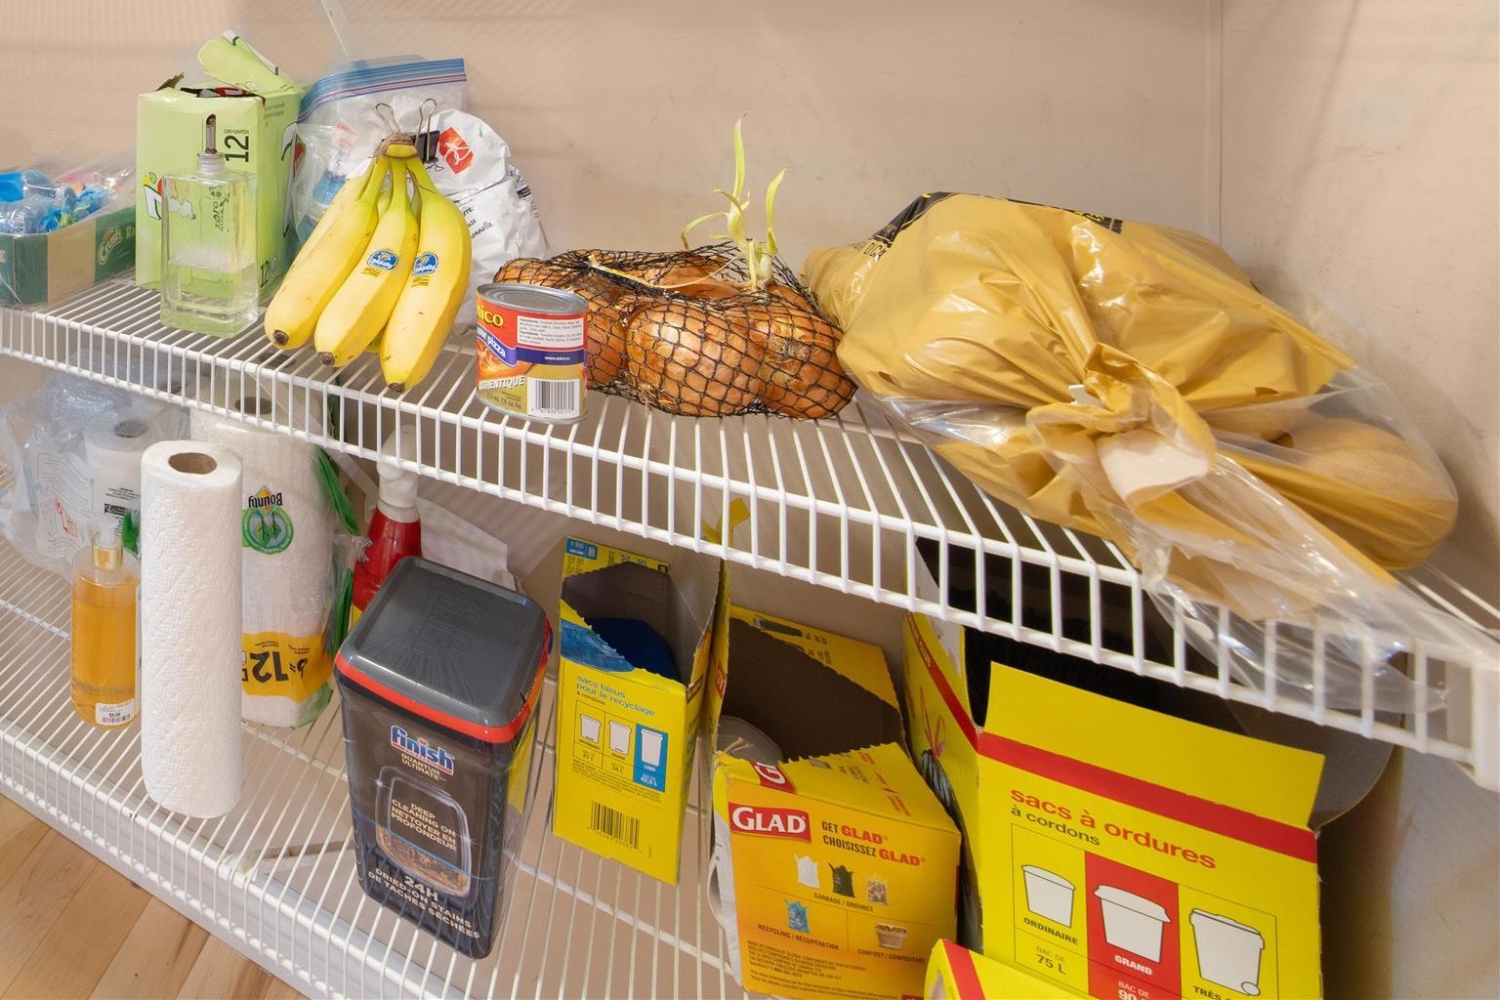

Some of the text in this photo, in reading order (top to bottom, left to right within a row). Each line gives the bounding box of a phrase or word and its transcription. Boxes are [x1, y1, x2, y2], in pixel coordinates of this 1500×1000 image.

[224, 136, 249, 162] 12
[476, 304, 504, 327] nico
[487, 336, 506, 358] pizza
[248, 492, 283, 508] Bounty
[577, 676, 626, 698] sacs bleus
[576, 683, 655, 716] pour le recyclage
[390, 725, 453, 772] finish
[401, 753, 440, 775] QUANTUM
[402, 758, 440, 780] ULTIMATE
[392, 799, 456, 837] CLEANING ON
[411, 803, 435, 819] DEEP
[732, 807, 806, 834] GLAD
[391, 806, 457, 845] NETTOYER EN
[391, 812, 457, 852] PROFONDEUR
[821, 821, 883, 844] GET GLAD
[1011, 804, 1100, 845] à cordons
[1011, 789, 1216, 869] sacs à ordures
[823, 835, 920, 866] CHOISISSEZ GLAD
[368, 871, 381, 884] DE
[385, 882, 426, 910] TACHES
[375, 868, 471, 928] DRIED-ON STAINS
[404, 875, 438, 901] 24H
[814, 892, 840, 905] GARBAGE
[758, 924, 790, 939] RECYCLING
[1023, 917, 1078, 945] ORDINAIRE
[857, 949, 884, 958] COMPOST
[889, 952, 926, 963] COMPOSTAGE
[1036, 954, 1067, 975] 75 L
[1114, 955, 1153, 975] GRAND
[1118, 980, 1150, 999] BAC DE
